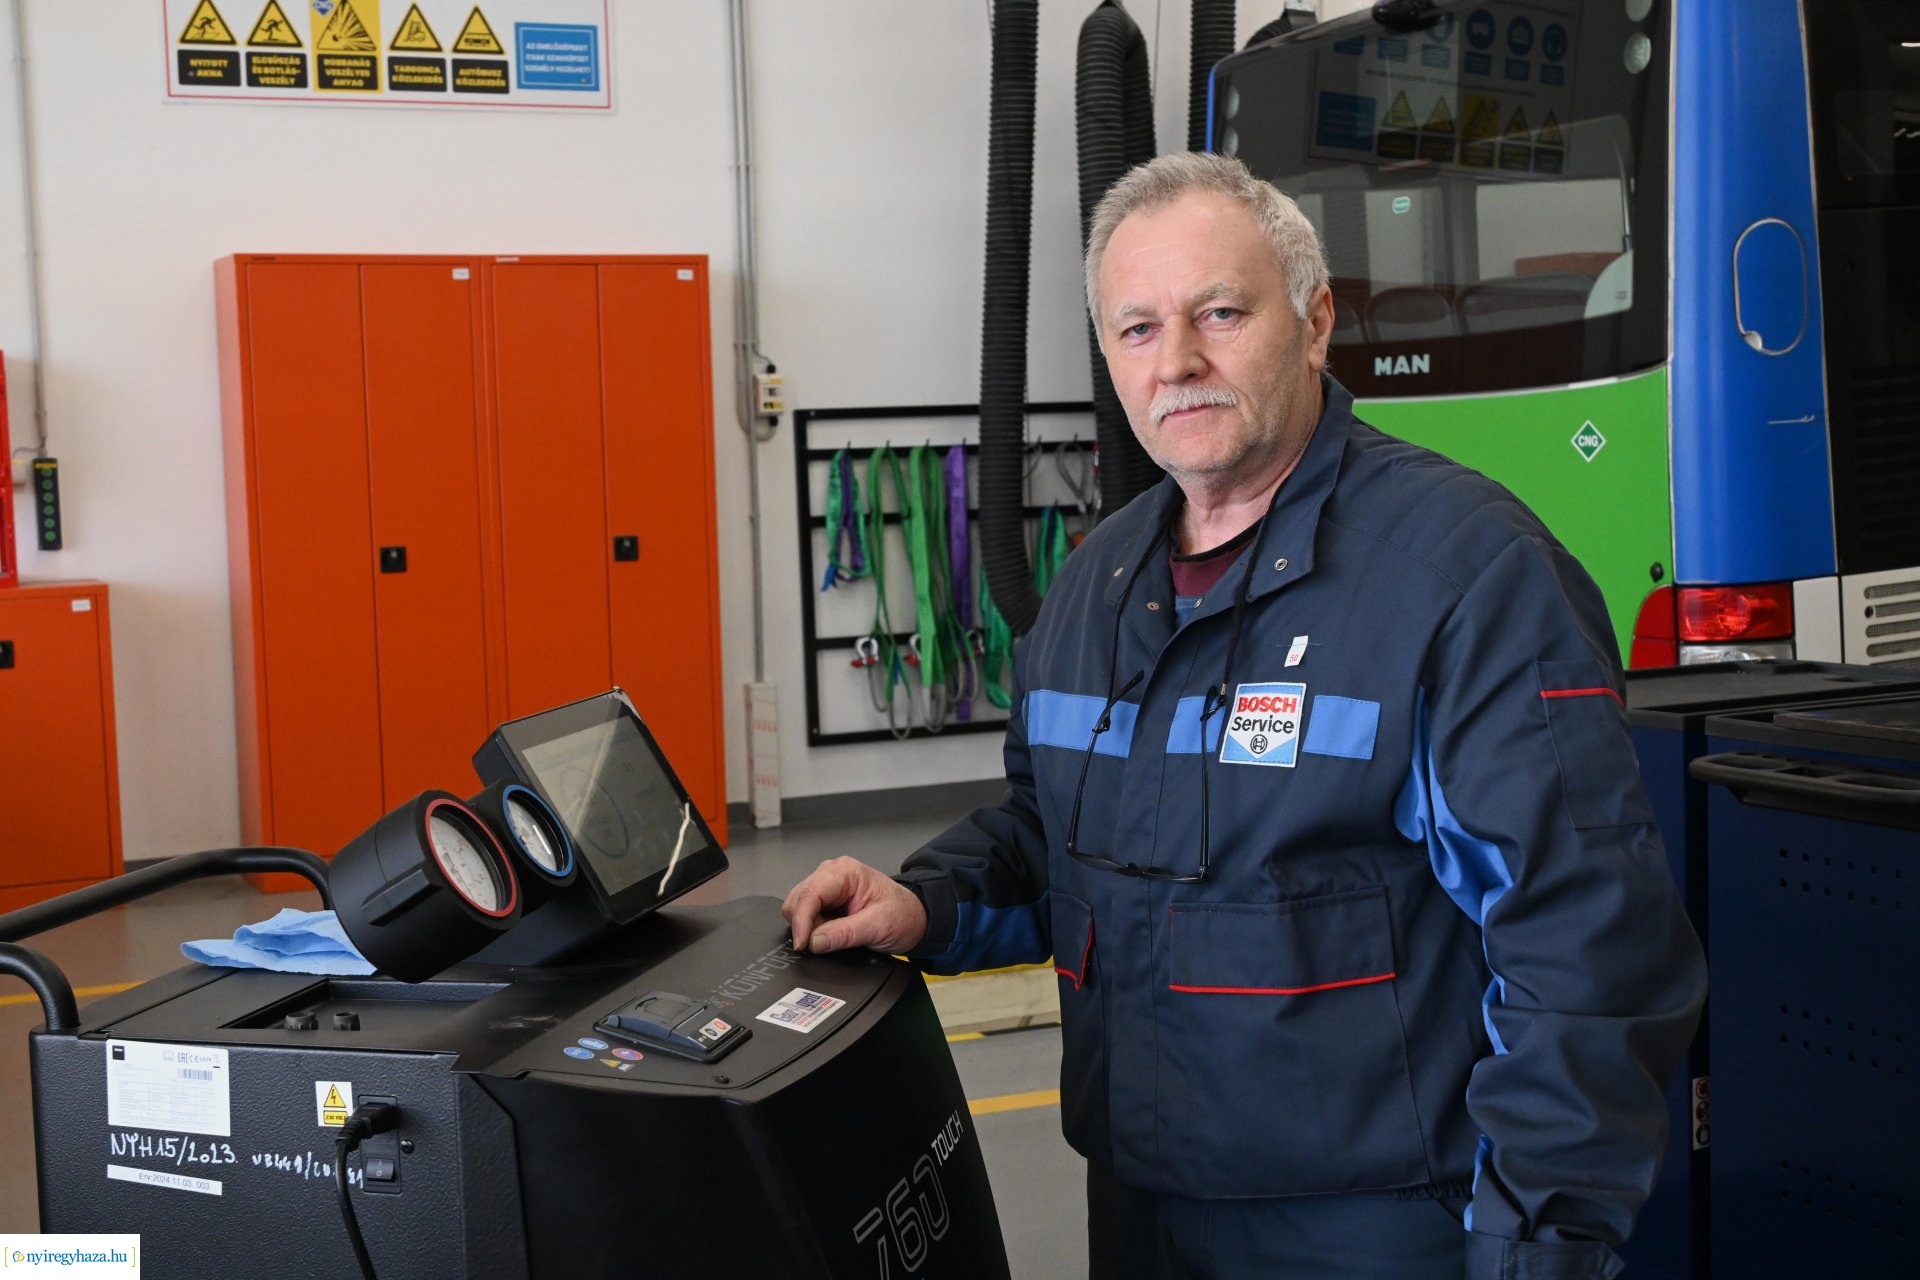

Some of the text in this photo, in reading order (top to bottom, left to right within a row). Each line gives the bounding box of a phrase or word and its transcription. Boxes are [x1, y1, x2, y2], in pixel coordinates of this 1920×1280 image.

[190, 58, 229, 68] NYITOTT
[1374, 353, 1431, 376] MAN
[1577, 434, 1599, 448] CNG
[1237, 696, 1297, 713] BOSCH
[1231, 714, 1295, 734] Service
[931, 1109, 964, 1167] TOUCH
[853, 1154, 950, 1280] 760
